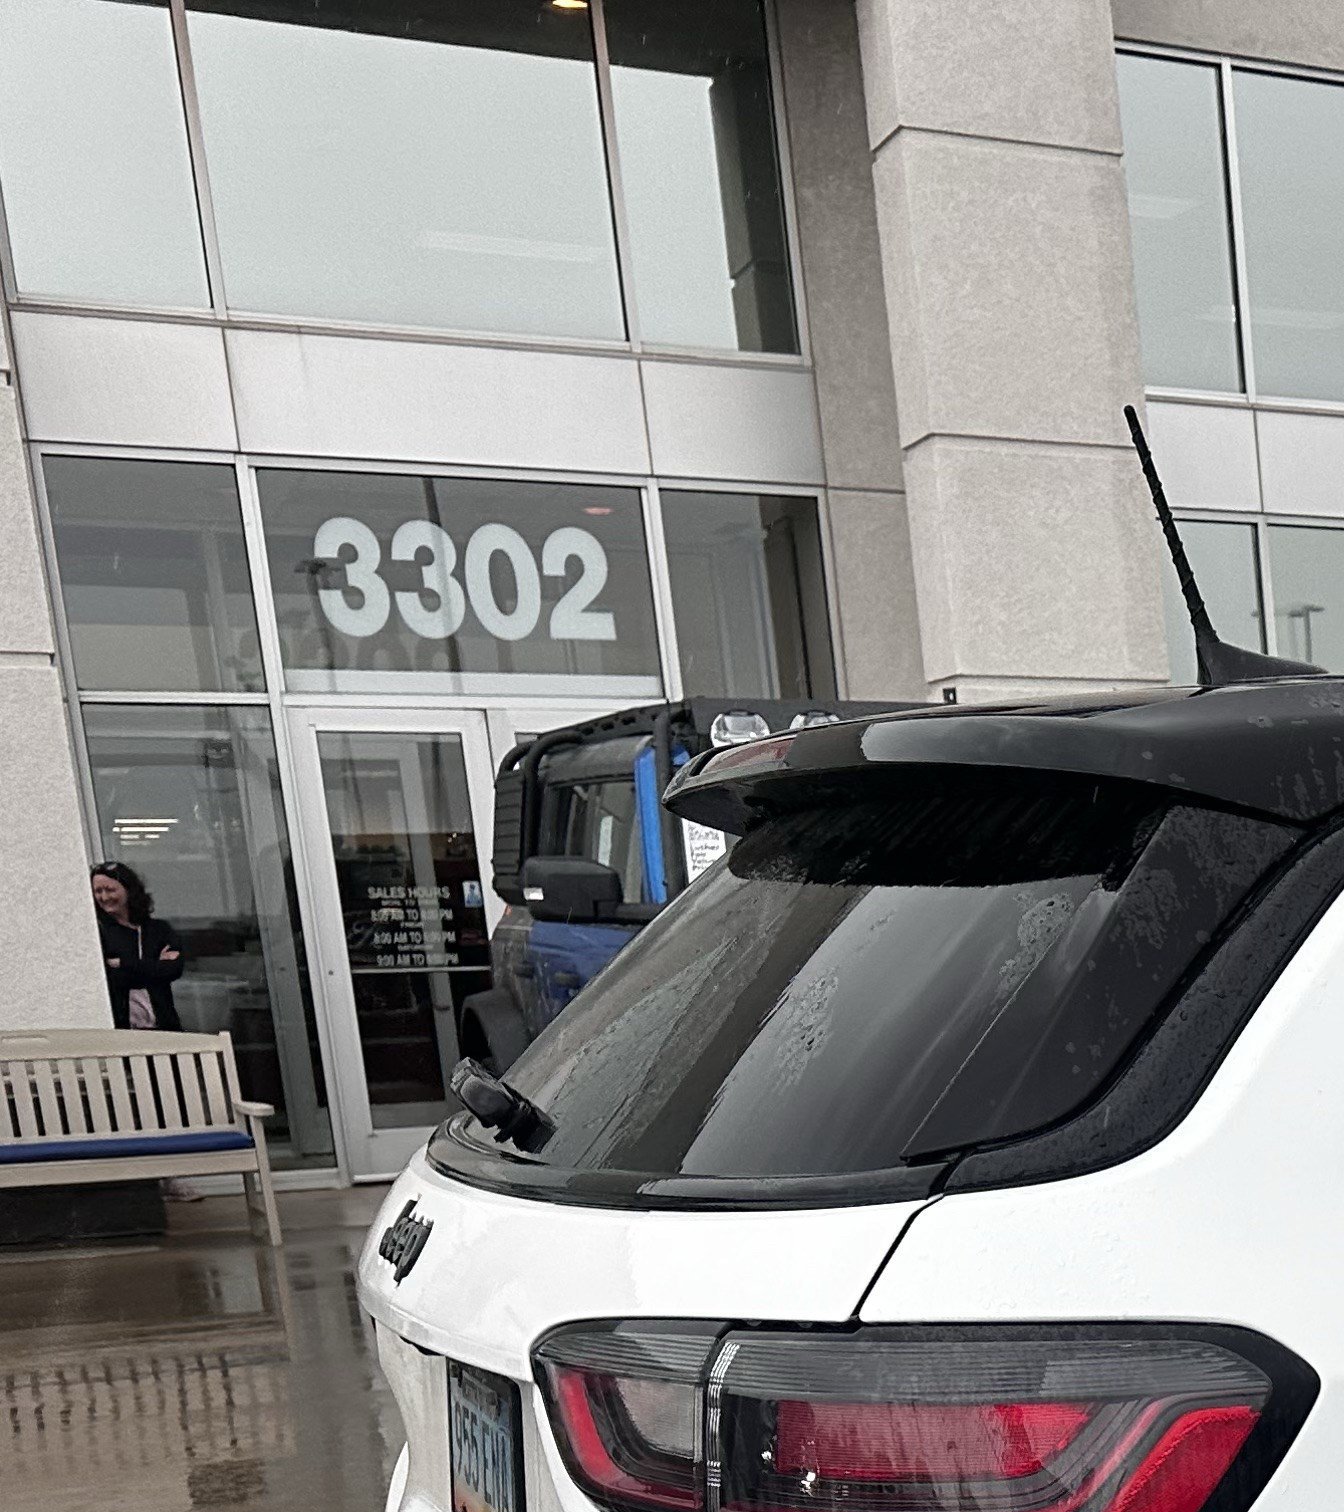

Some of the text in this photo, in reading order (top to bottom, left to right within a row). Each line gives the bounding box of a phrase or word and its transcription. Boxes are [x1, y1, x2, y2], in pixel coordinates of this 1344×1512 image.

[314, 517, 617, 641] 3302
[367, 886, 451, 899] SALES HOURS
[409, 931, 422, 944] TO
[454, 1400, 480, 1494] 955
